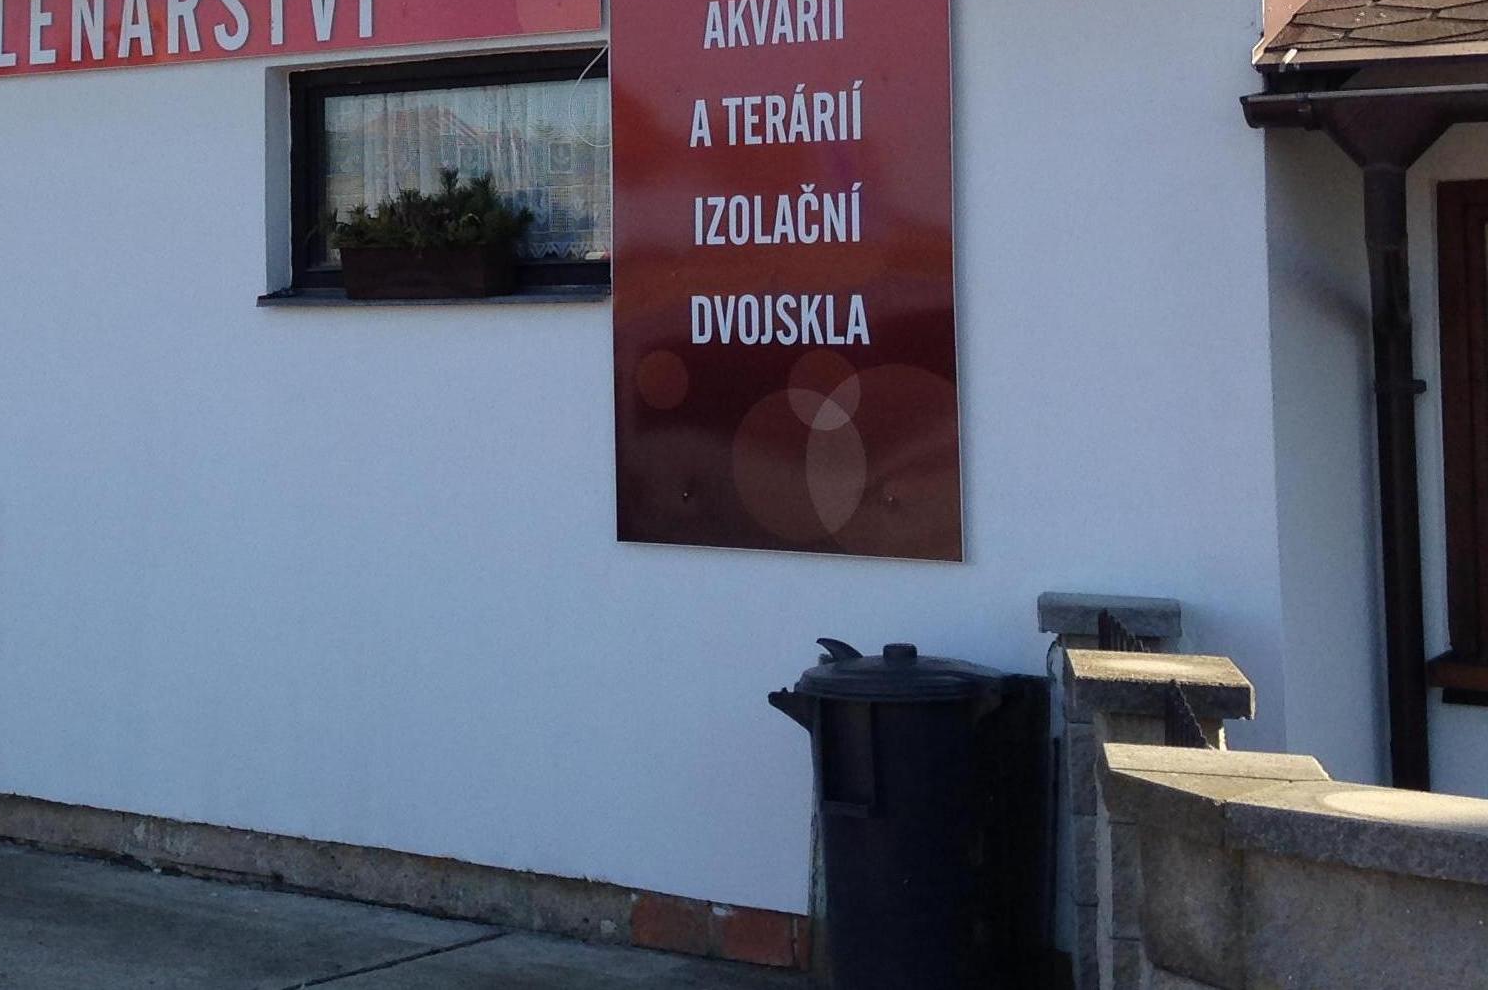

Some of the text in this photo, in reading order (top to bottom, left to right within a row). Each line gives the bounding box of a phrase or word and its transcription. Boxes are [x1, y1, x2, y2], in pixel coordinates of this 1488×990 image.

[689, 80, 864, 147] A TERÁRIÍ
[694, 183, 862, 245] IZOLAČNÍ
[690, 293, 870, 346] DVOJSKLA
